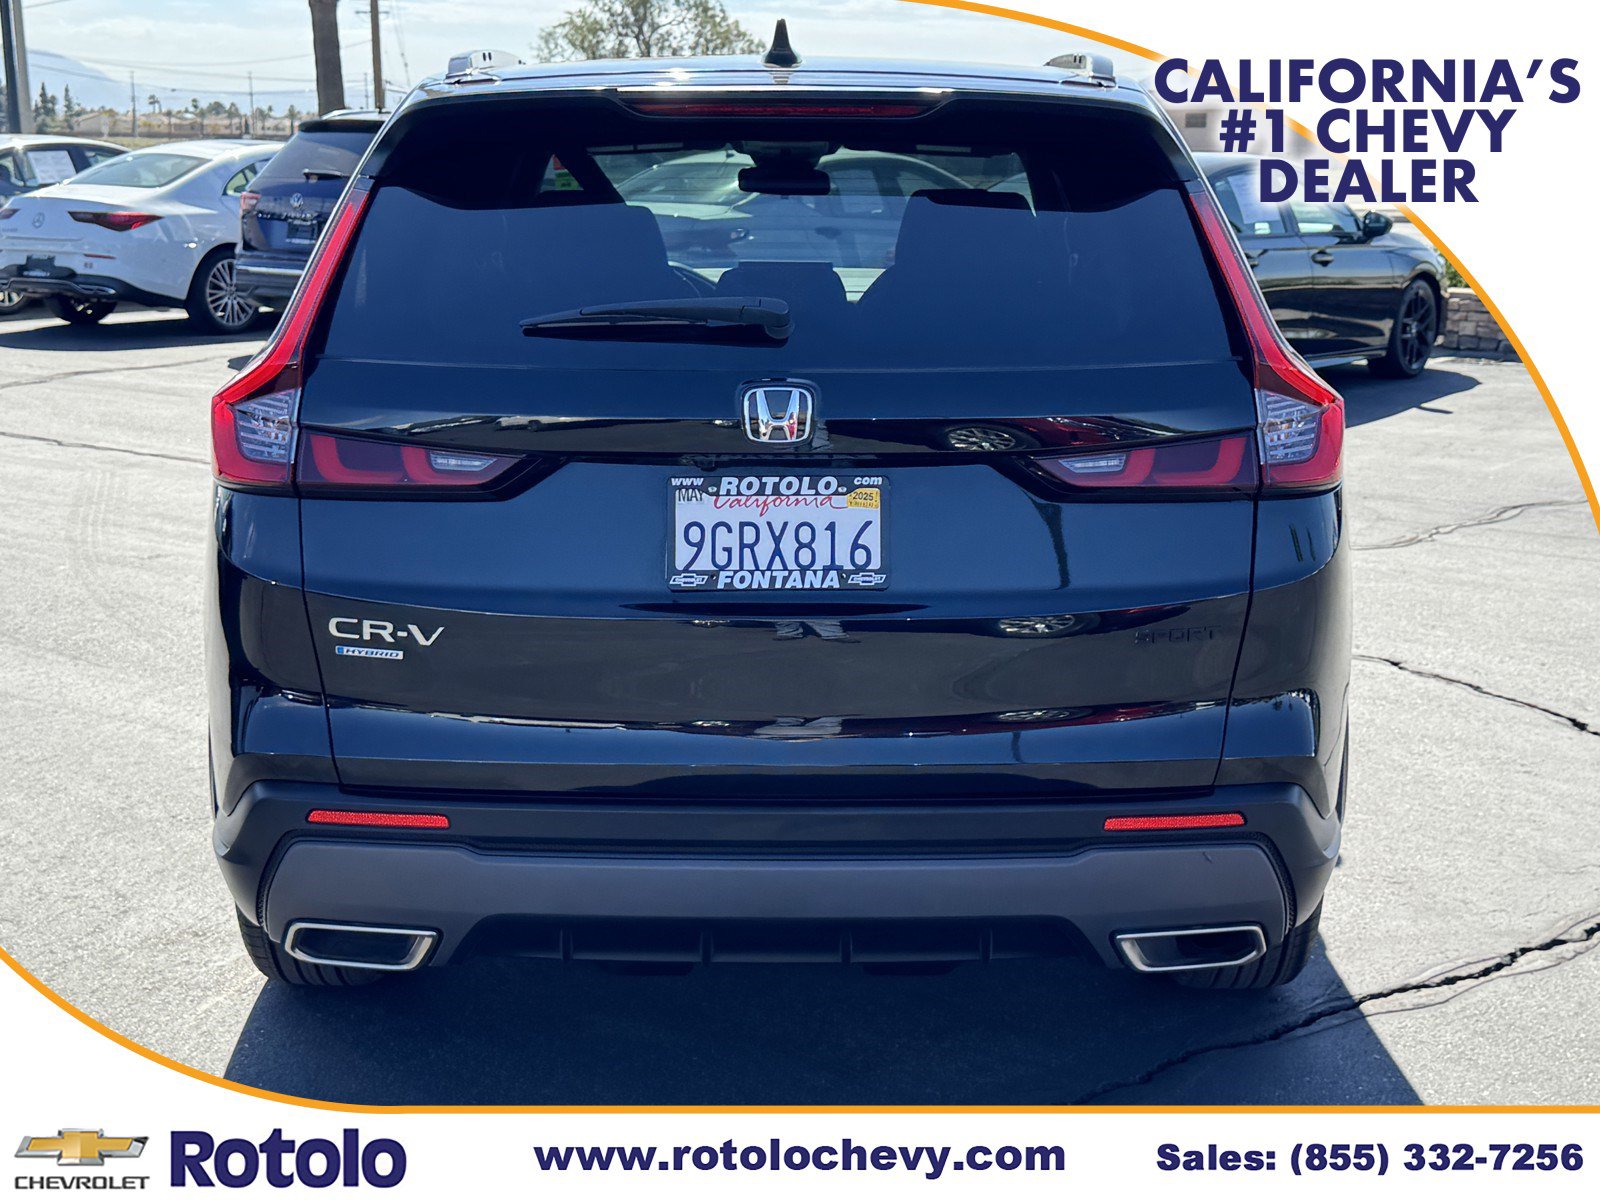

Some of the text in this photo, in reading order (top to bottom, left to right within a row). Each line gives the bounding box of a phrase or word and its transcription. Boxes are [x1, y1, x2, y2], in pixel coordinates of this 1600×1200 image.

[671, 476, 882, 496] www ROTOLO com
[853, 491, 874, 501] 2025
[713, 495, 848, 517] California
[683, 520, 873, 571] 9GRX816
[716, 570, 841, 590] FONTANA
[328, 617, 445, 646] CR-V
[345, 648, 400, 658] HYBRID
